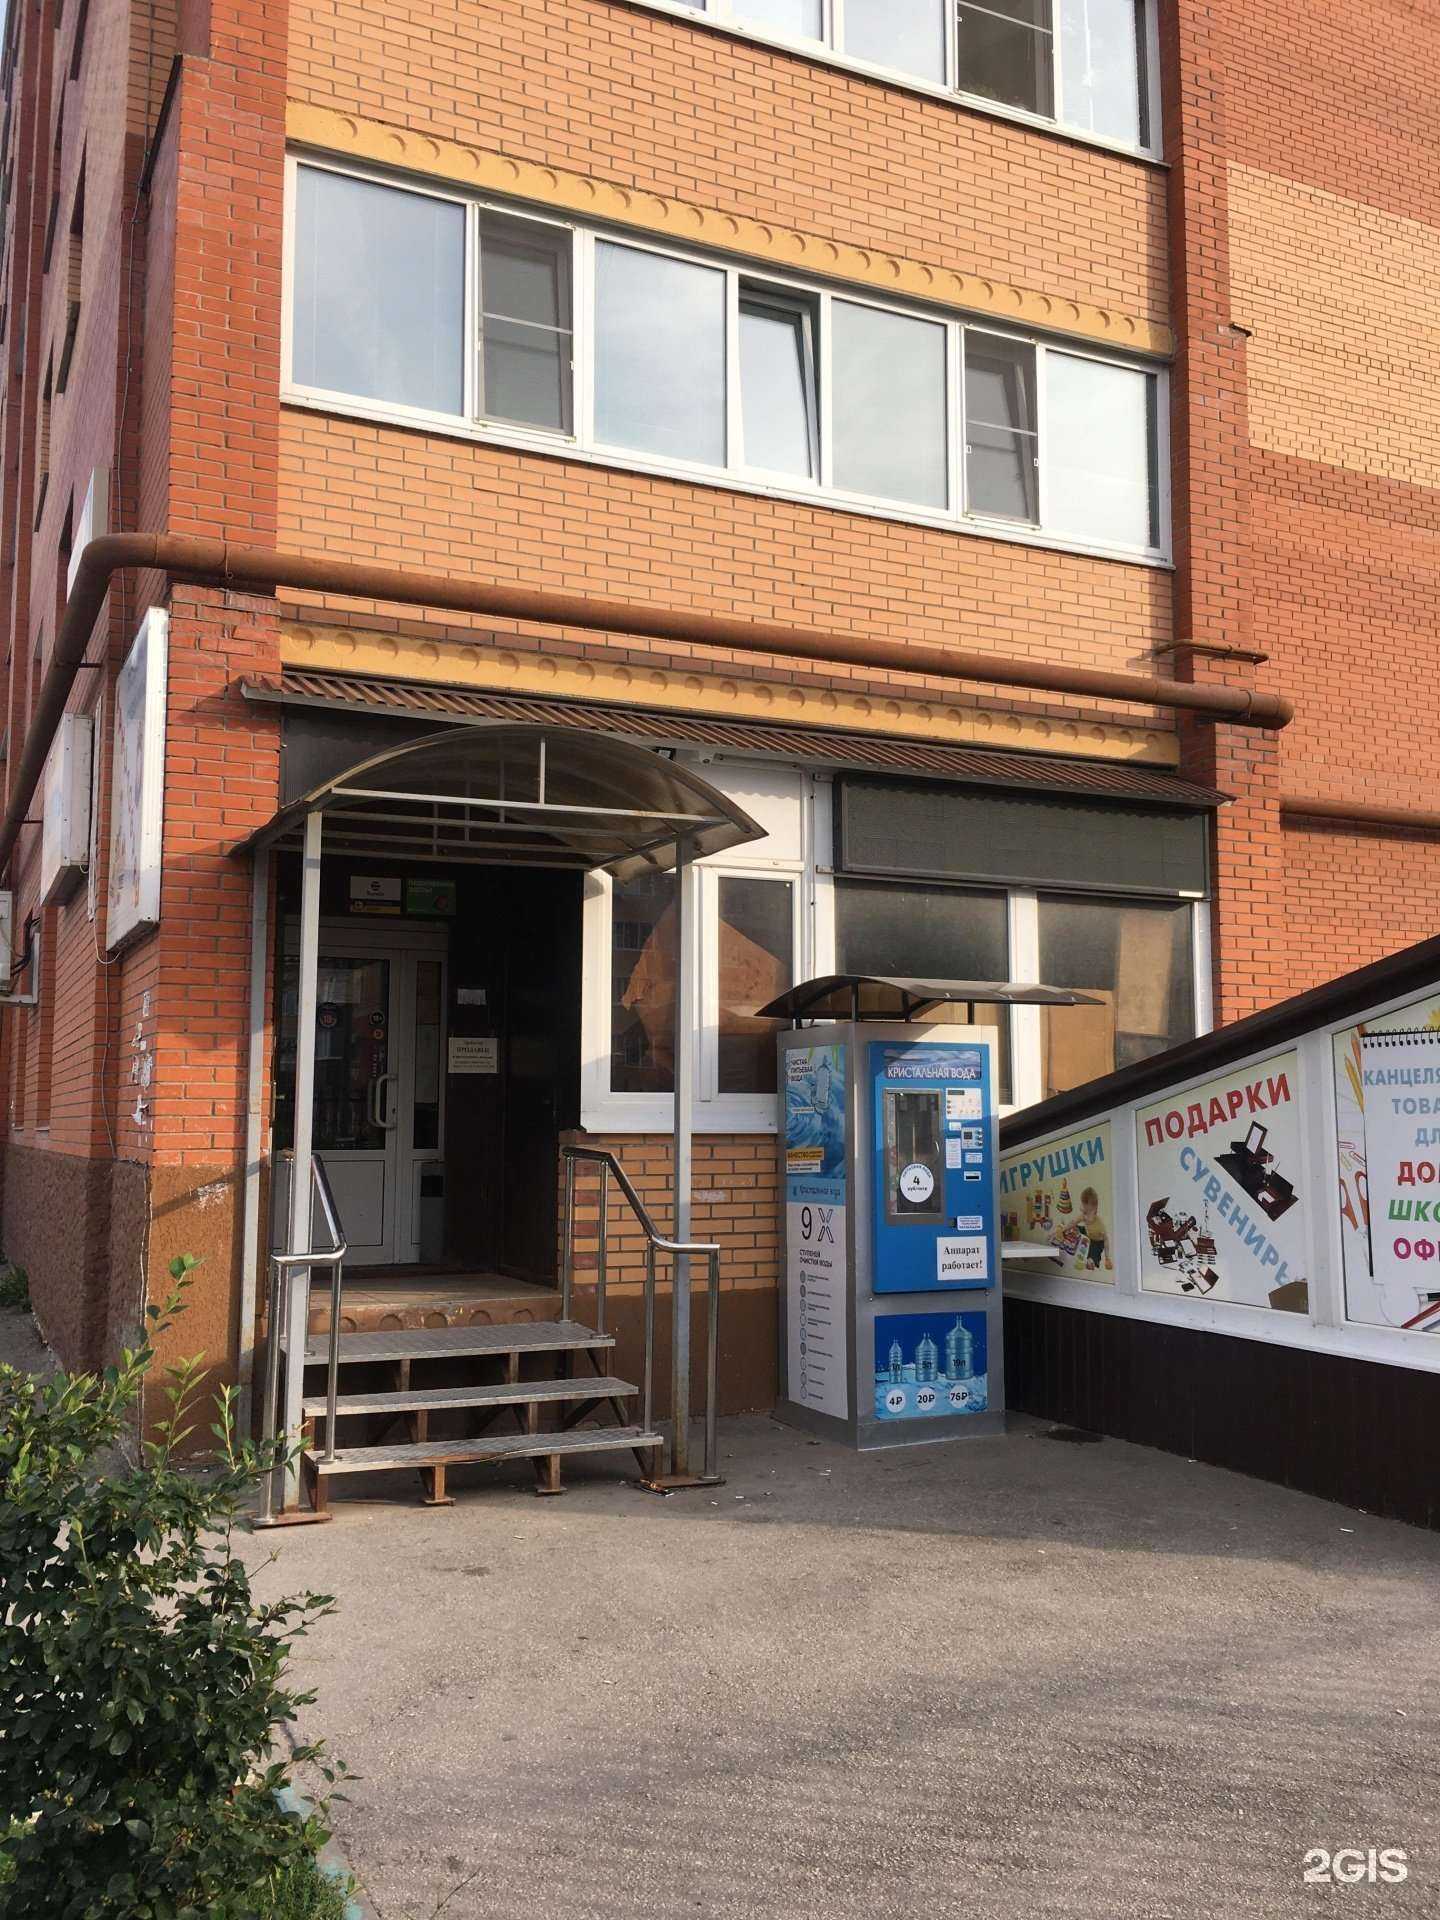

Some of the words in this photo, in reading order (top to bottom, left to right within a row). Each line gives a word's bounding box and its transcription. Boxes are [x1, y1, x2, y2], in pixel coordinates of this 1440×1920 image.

[887, 1066, 950, 1079] КРИСТАЛЬНАЯ
[951, 1066, 976, 1080] ВОДА
[1145, 1073, 1291, 1146] ПОДАРКИ
[999, 1136, 1105, 1195] ИГРУШКИ
[1397, 1161, 1440, 1186] ДО
[913, 1175, 921, 1185] 4
[801, 1206, 812, 1240] 9
[944, 1246, 981, 1256] Аппарат
[1393, 1237, 1440, 1260] ОФ
[941, 1259, 983, 1272] работает!
[952, 1358, 966, 1367] 19л
